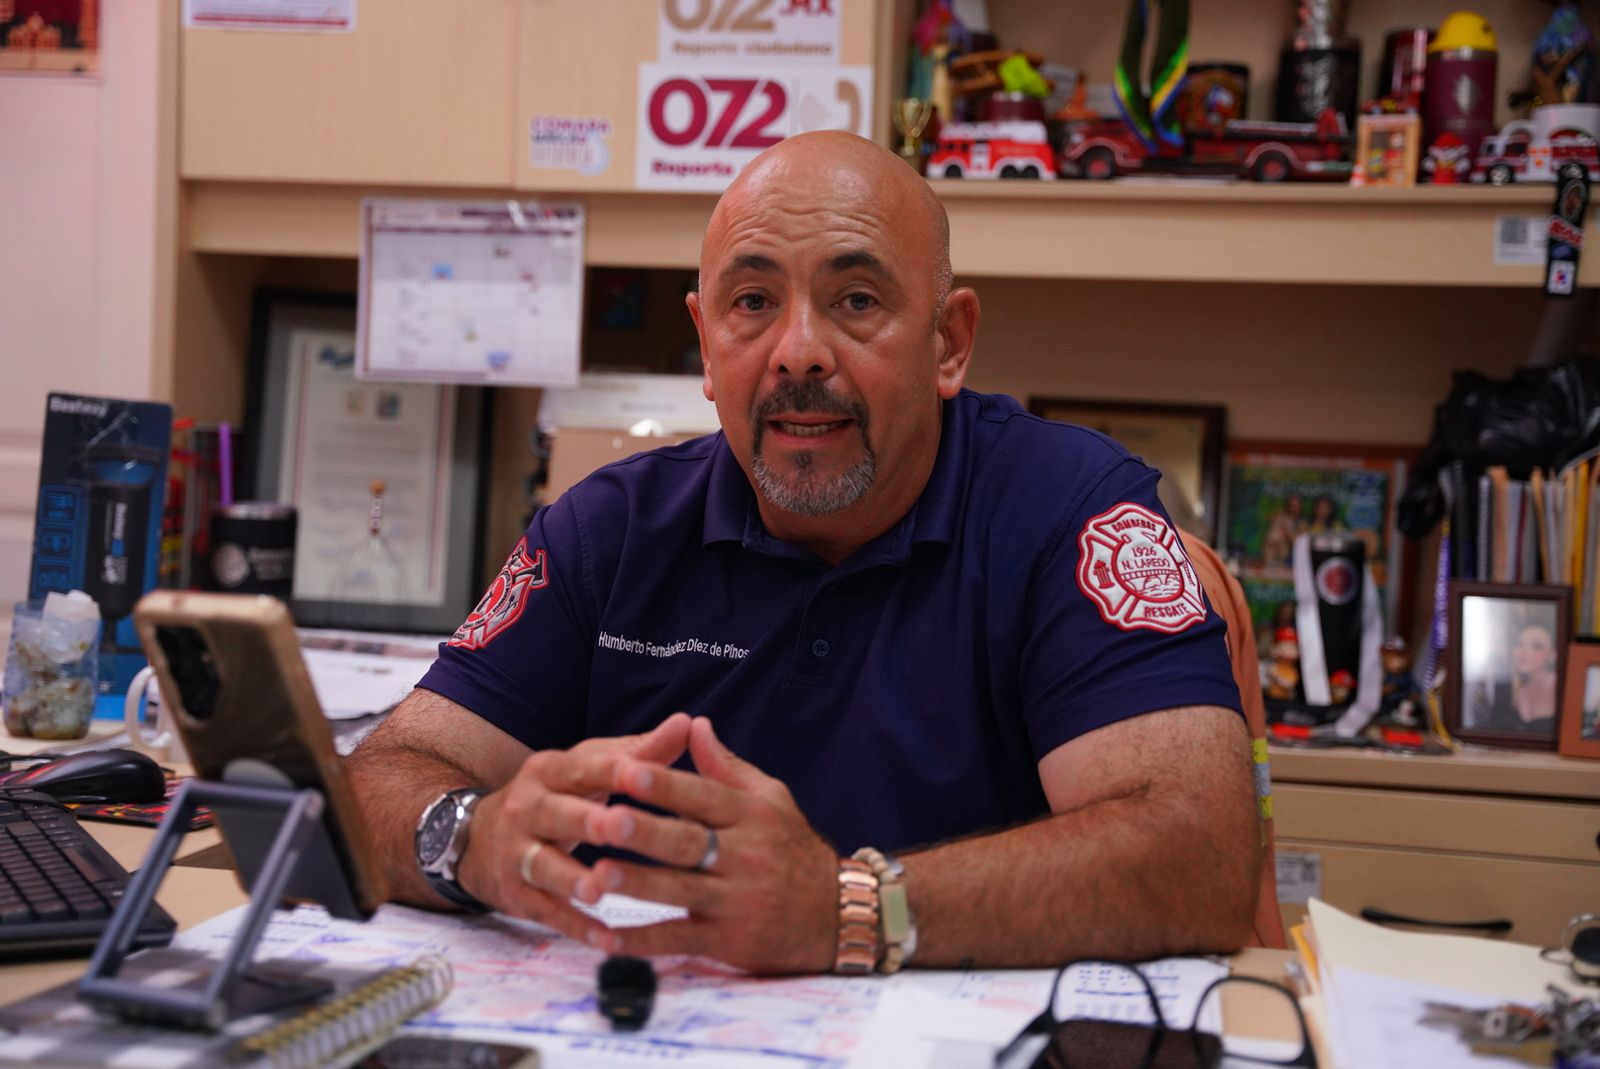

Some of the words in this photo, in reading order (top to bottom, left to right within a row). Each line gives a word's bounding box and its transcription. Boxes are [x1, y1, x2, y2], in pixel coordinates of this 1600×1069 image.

[648, 76, 787, 149] 072
[652, 158, 734, 178] Reporte
[1111, 518, 1156, 533] BOMBEROS
[1131, 546, 1157, 558] 1926
[1135, 558, 1170, 569] LAREDO
[1143, 602, 1191, 619] RESCATE
[598, 631, 645, 655] Humberto
[645, 639, 687, 658] Fernández
[710, 641, 722, 656] de
